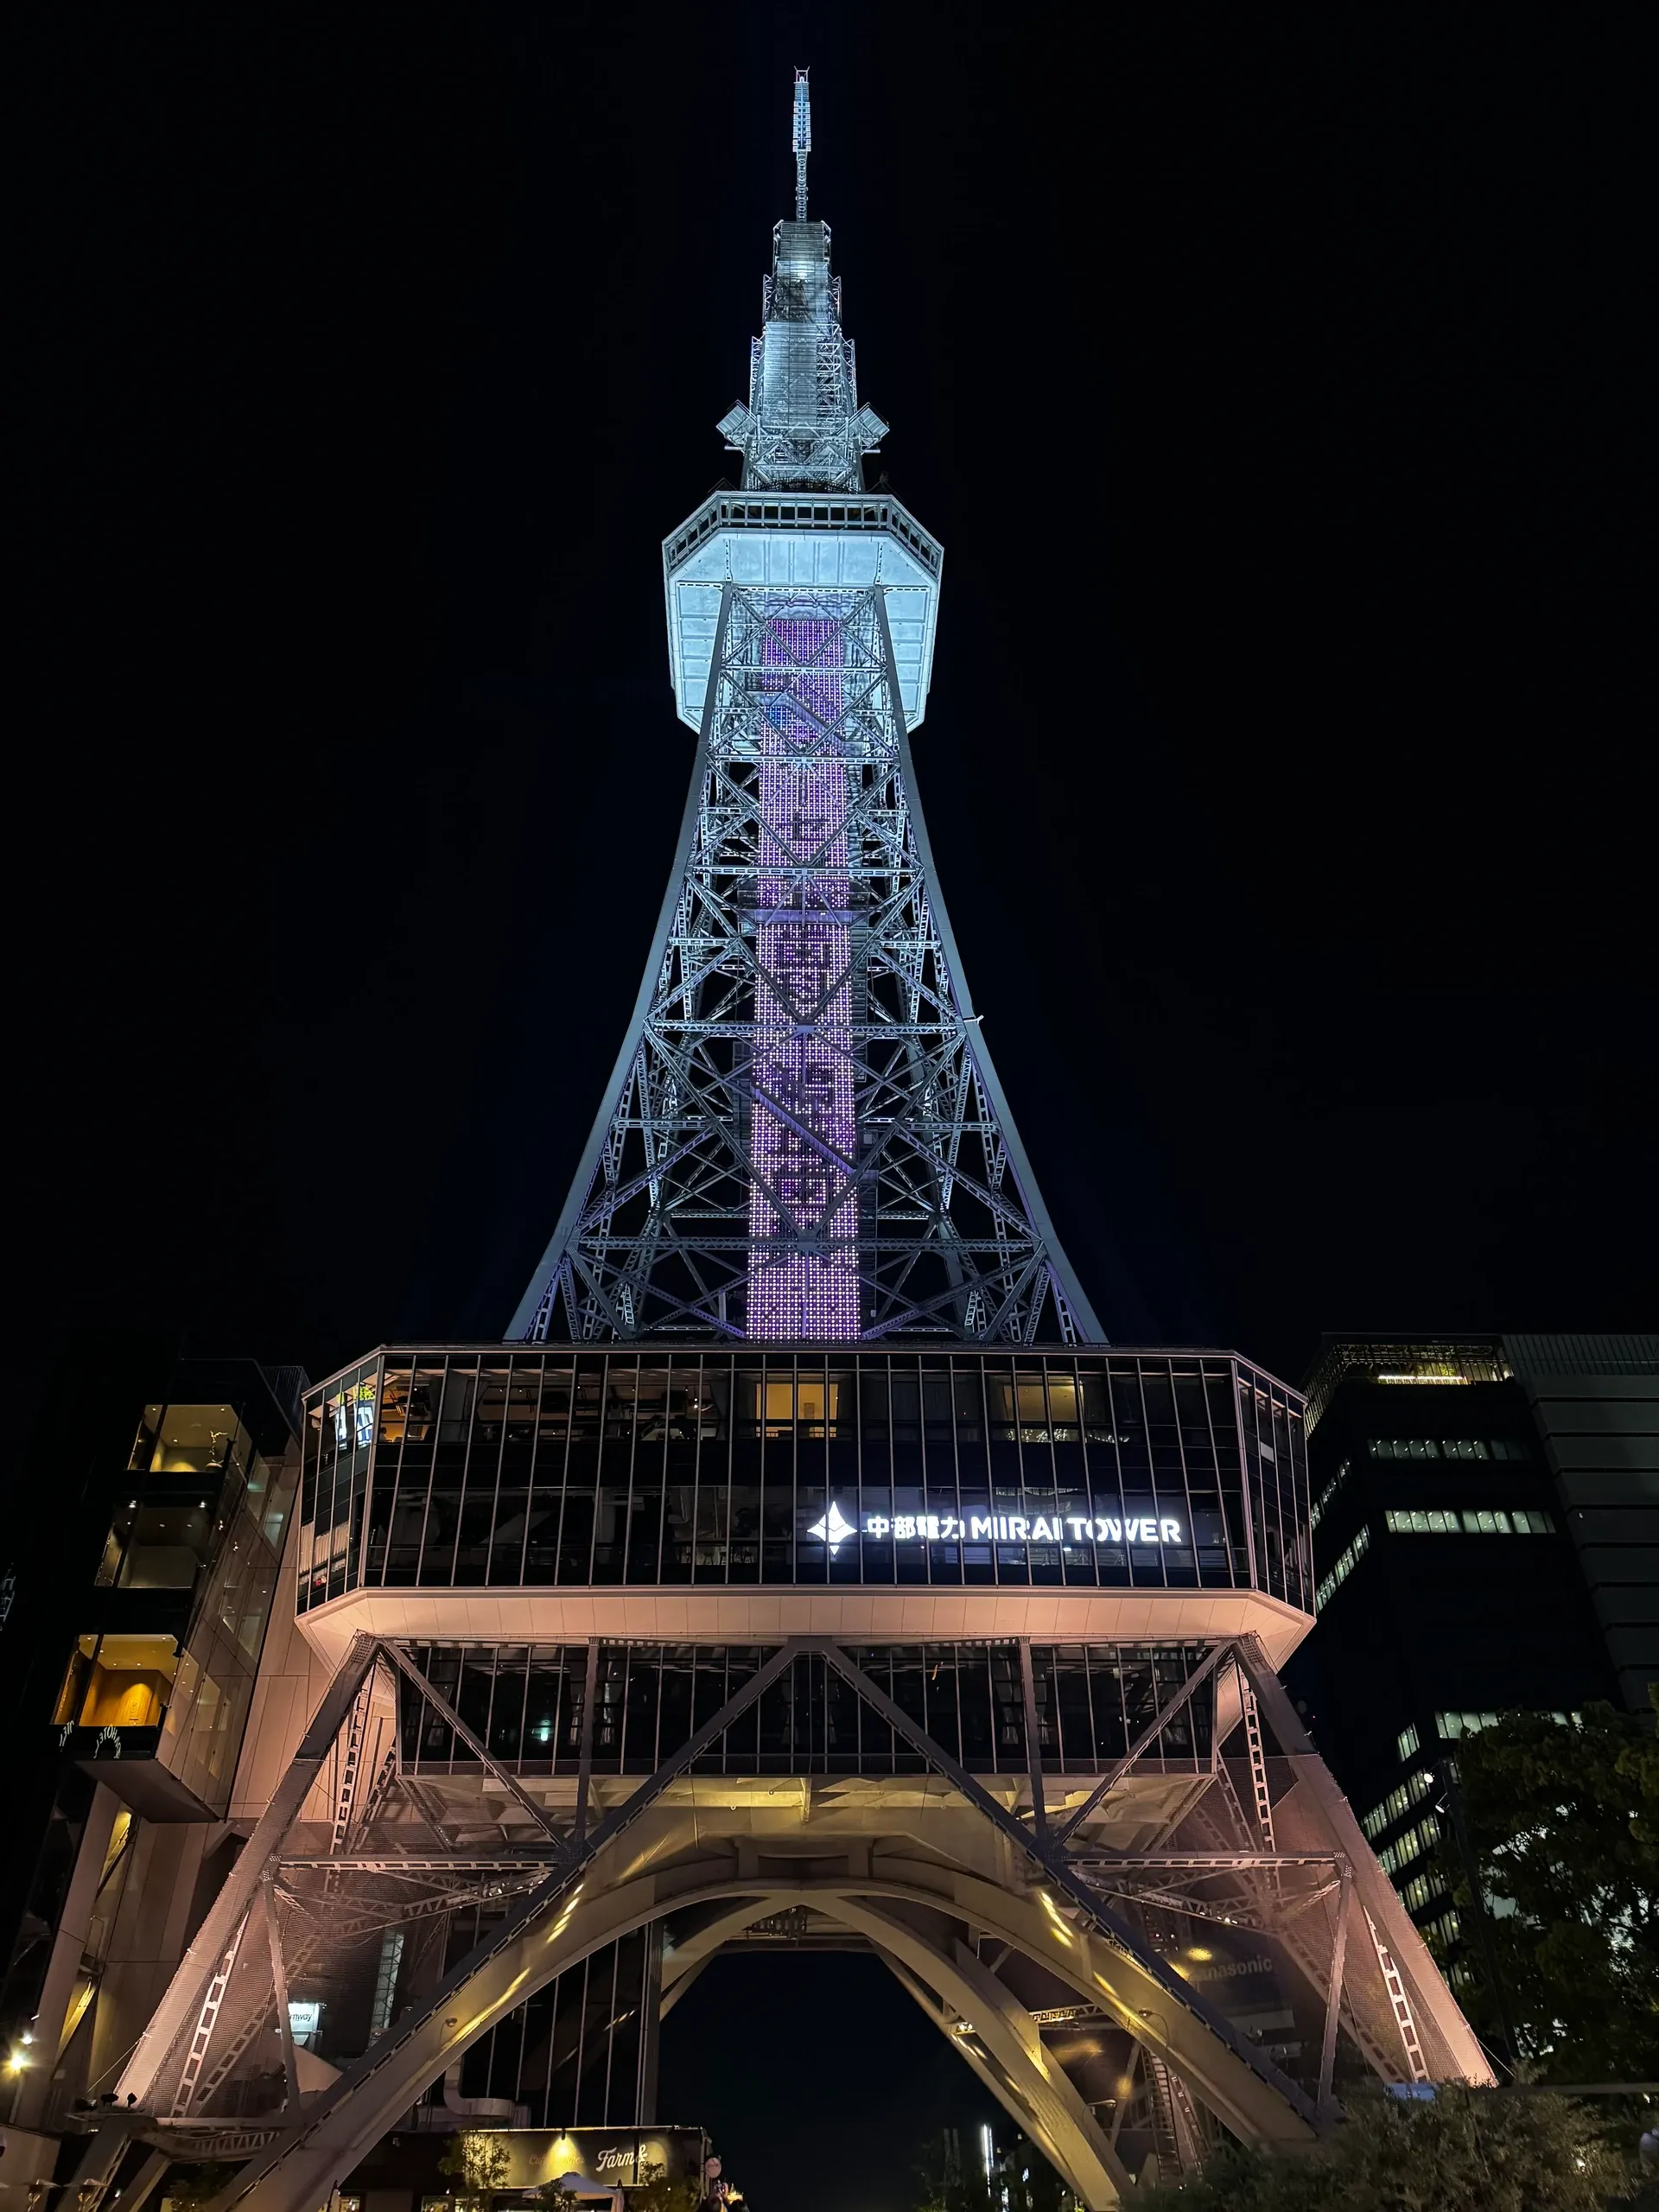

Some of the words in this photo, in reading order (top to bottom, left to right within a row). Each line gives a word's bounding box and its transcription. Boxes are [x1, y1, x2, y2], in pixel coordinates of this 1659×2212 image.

[867, 1516, 966, 1540] 中部電力
[970, 1516, 1064, 1541] MIRAI
[1066, 1517, 1182, 1543] TOWER
[289, 2012, 313, 2023] mway
